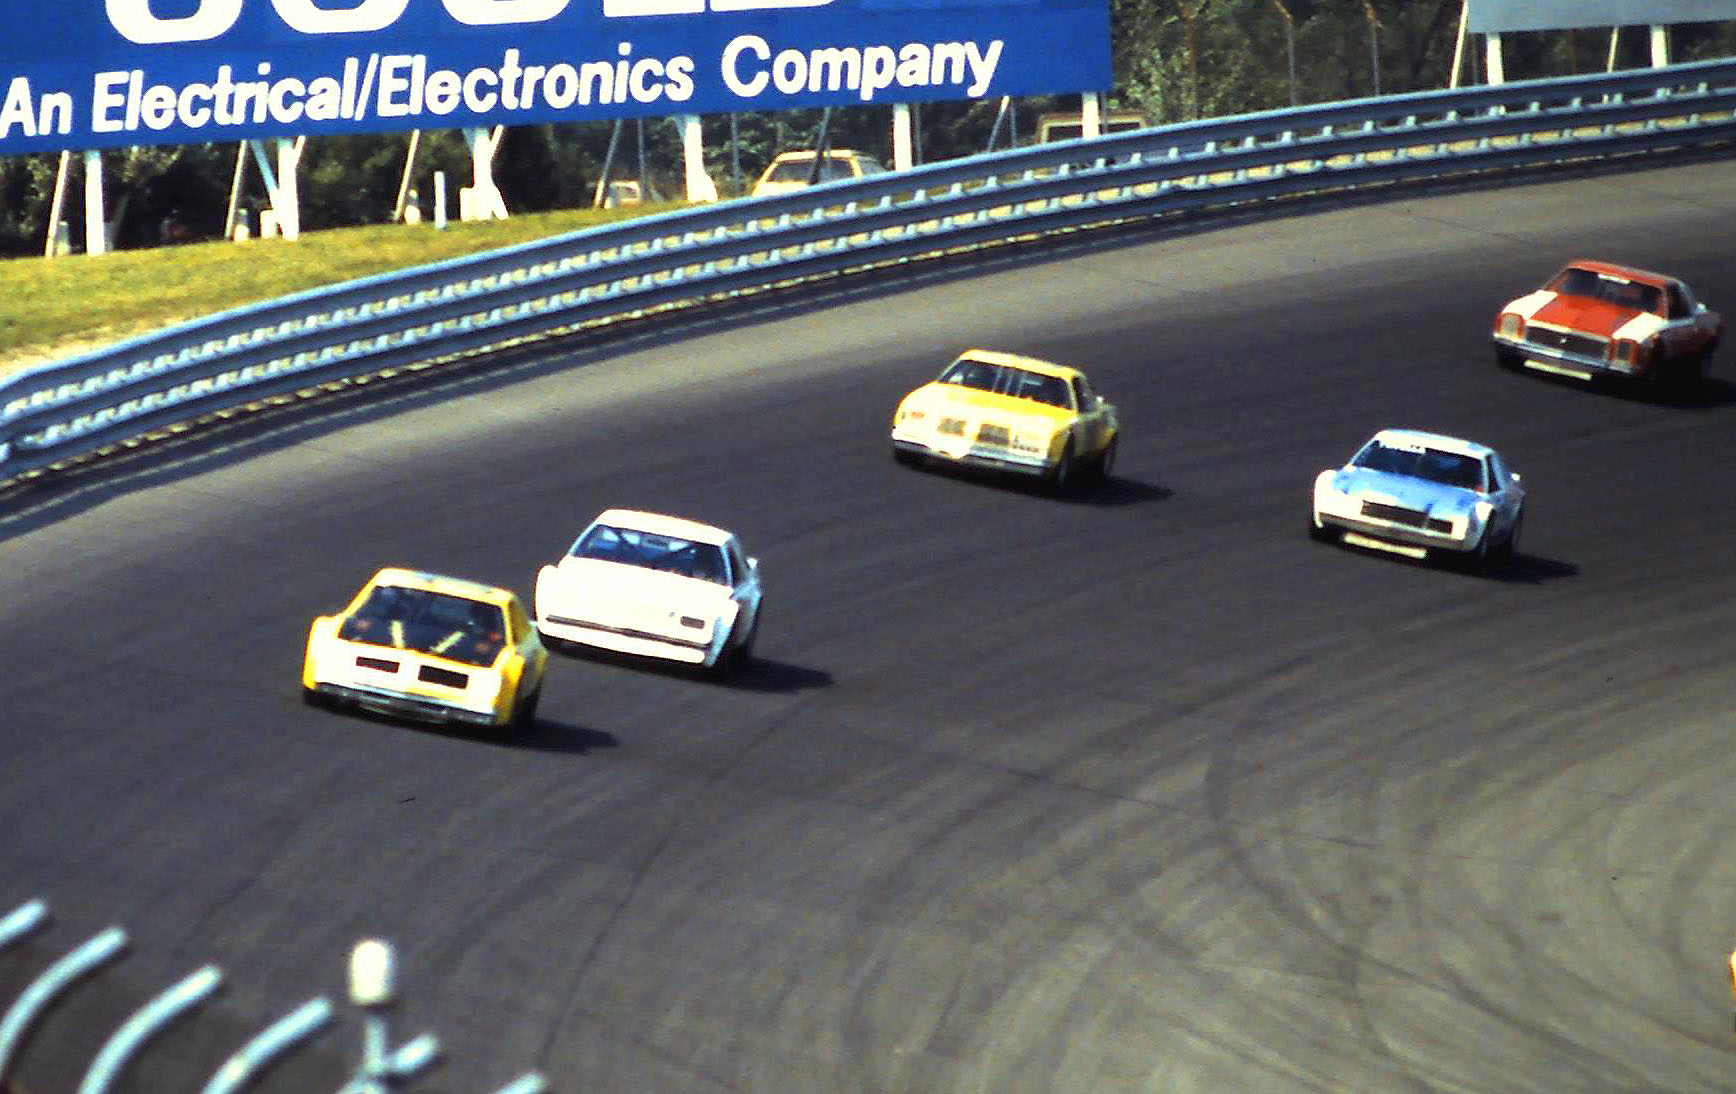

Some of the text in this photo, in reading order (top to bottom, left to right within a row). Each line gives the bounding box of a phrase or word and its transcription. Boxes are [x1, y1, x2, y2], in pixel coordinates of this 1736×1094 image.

[0, 34, 1004, 139] An Electrical/Electronics Company
